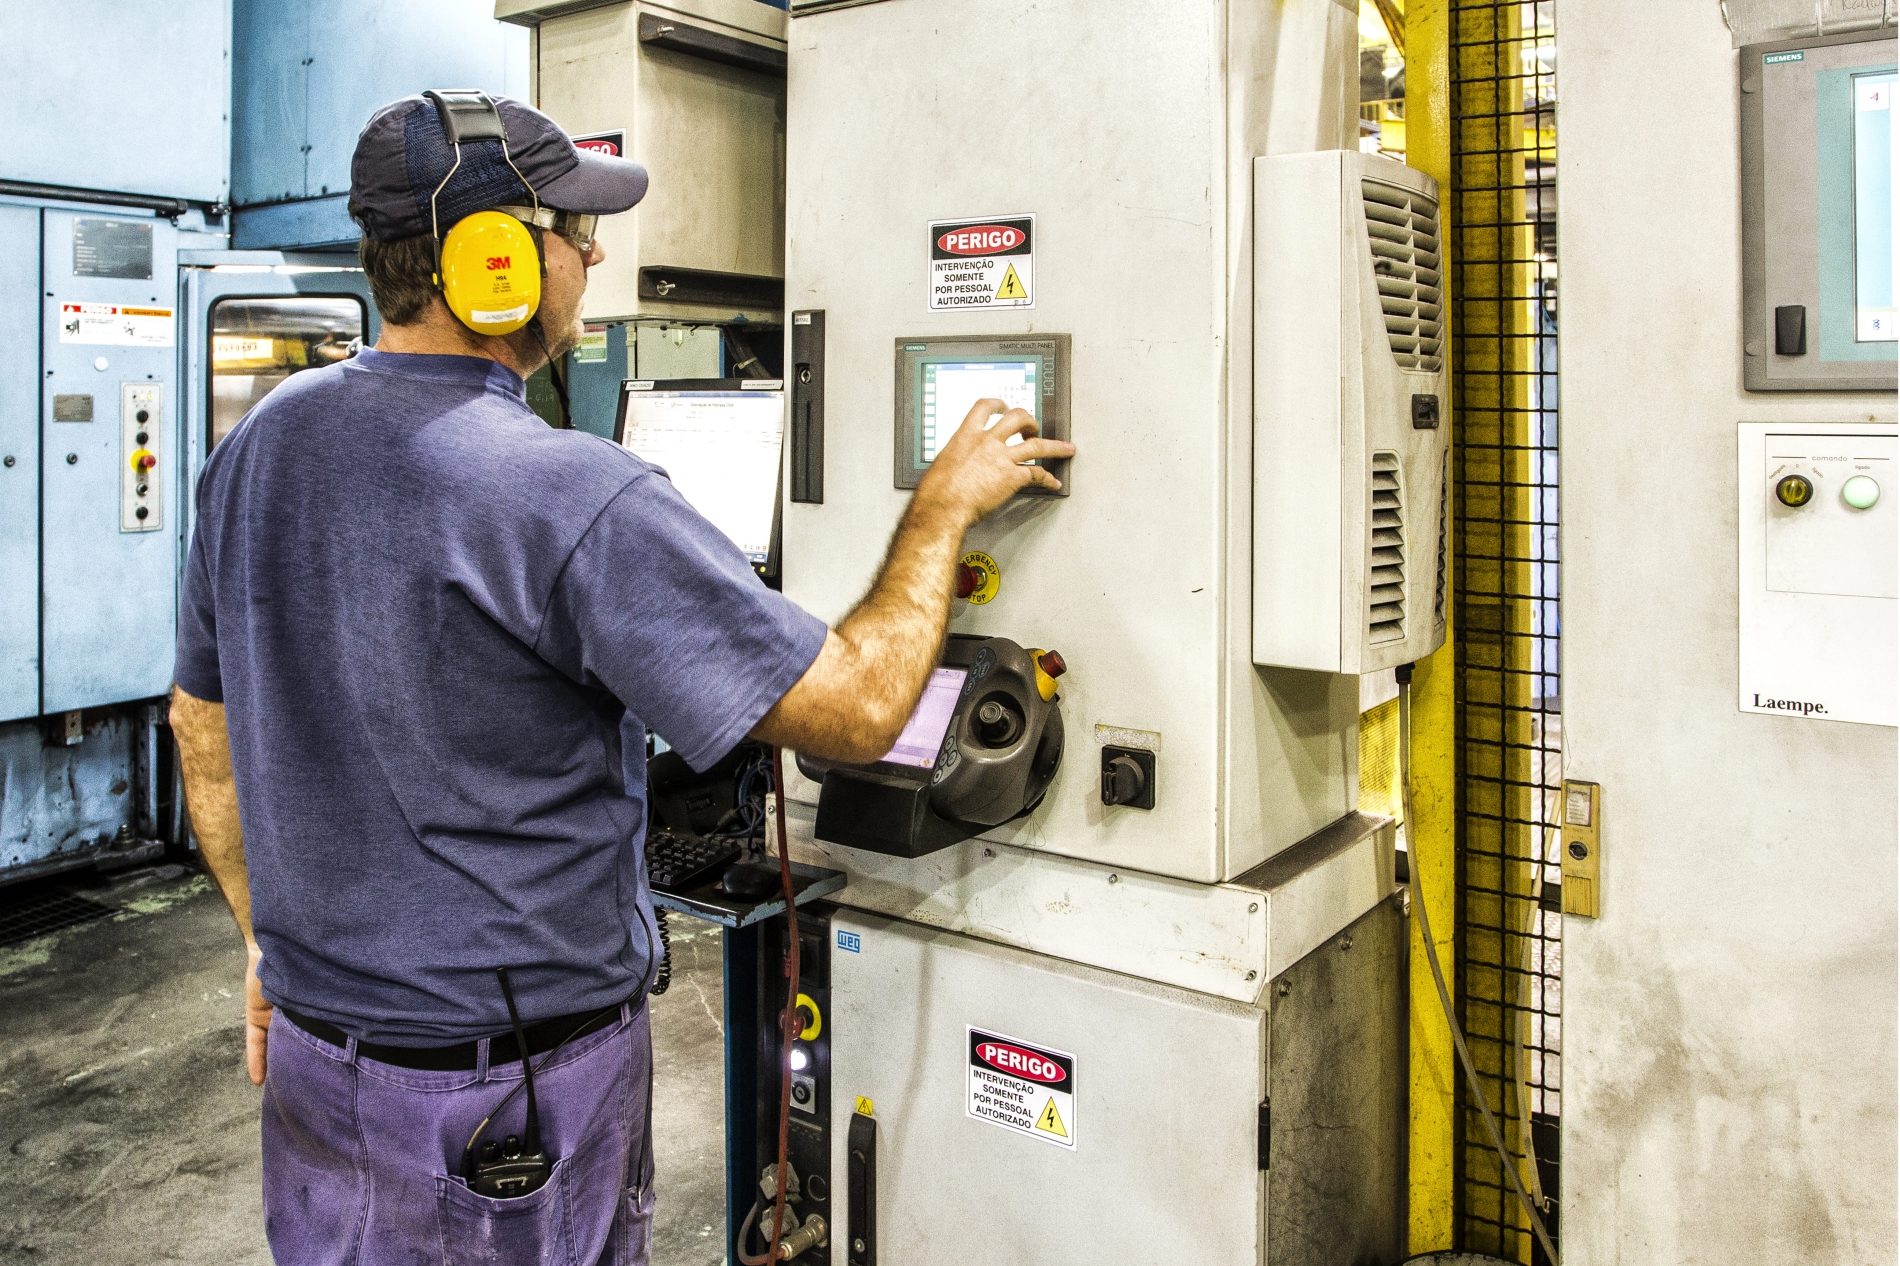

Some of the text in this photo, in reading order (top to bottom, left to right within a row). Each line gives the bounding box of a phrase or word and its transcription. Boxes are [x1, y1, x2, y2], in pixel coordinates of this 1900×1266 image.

[1767, 53, 1802, 63] SIEMENS
[946, 230, 1016, 250] PERIGO
[486, 256, 511, 270] 3M
[935, 259, 994, 271] INTERVENÇÃO
[944, 272, 984, 282] SOMENTE
[935, 284, 994, 294] POR PESSOAL
[937, 295, 991, 305] AUTORIZADO
[1042, 355, 1055, 397] TOUCH
[1753, 693, 1828, 716] Laempe.
[985, 1044, 1056, 1080] PERIGO
[973, 1069, 1034, 1095] INTERVENÇÃO
[982, 1083, 1024, 1103] SOMENTE
[973, 1092, 1034, 1118] POR PESSOAL
[976, 1105, 1031, 1129] AUTORIZADO
